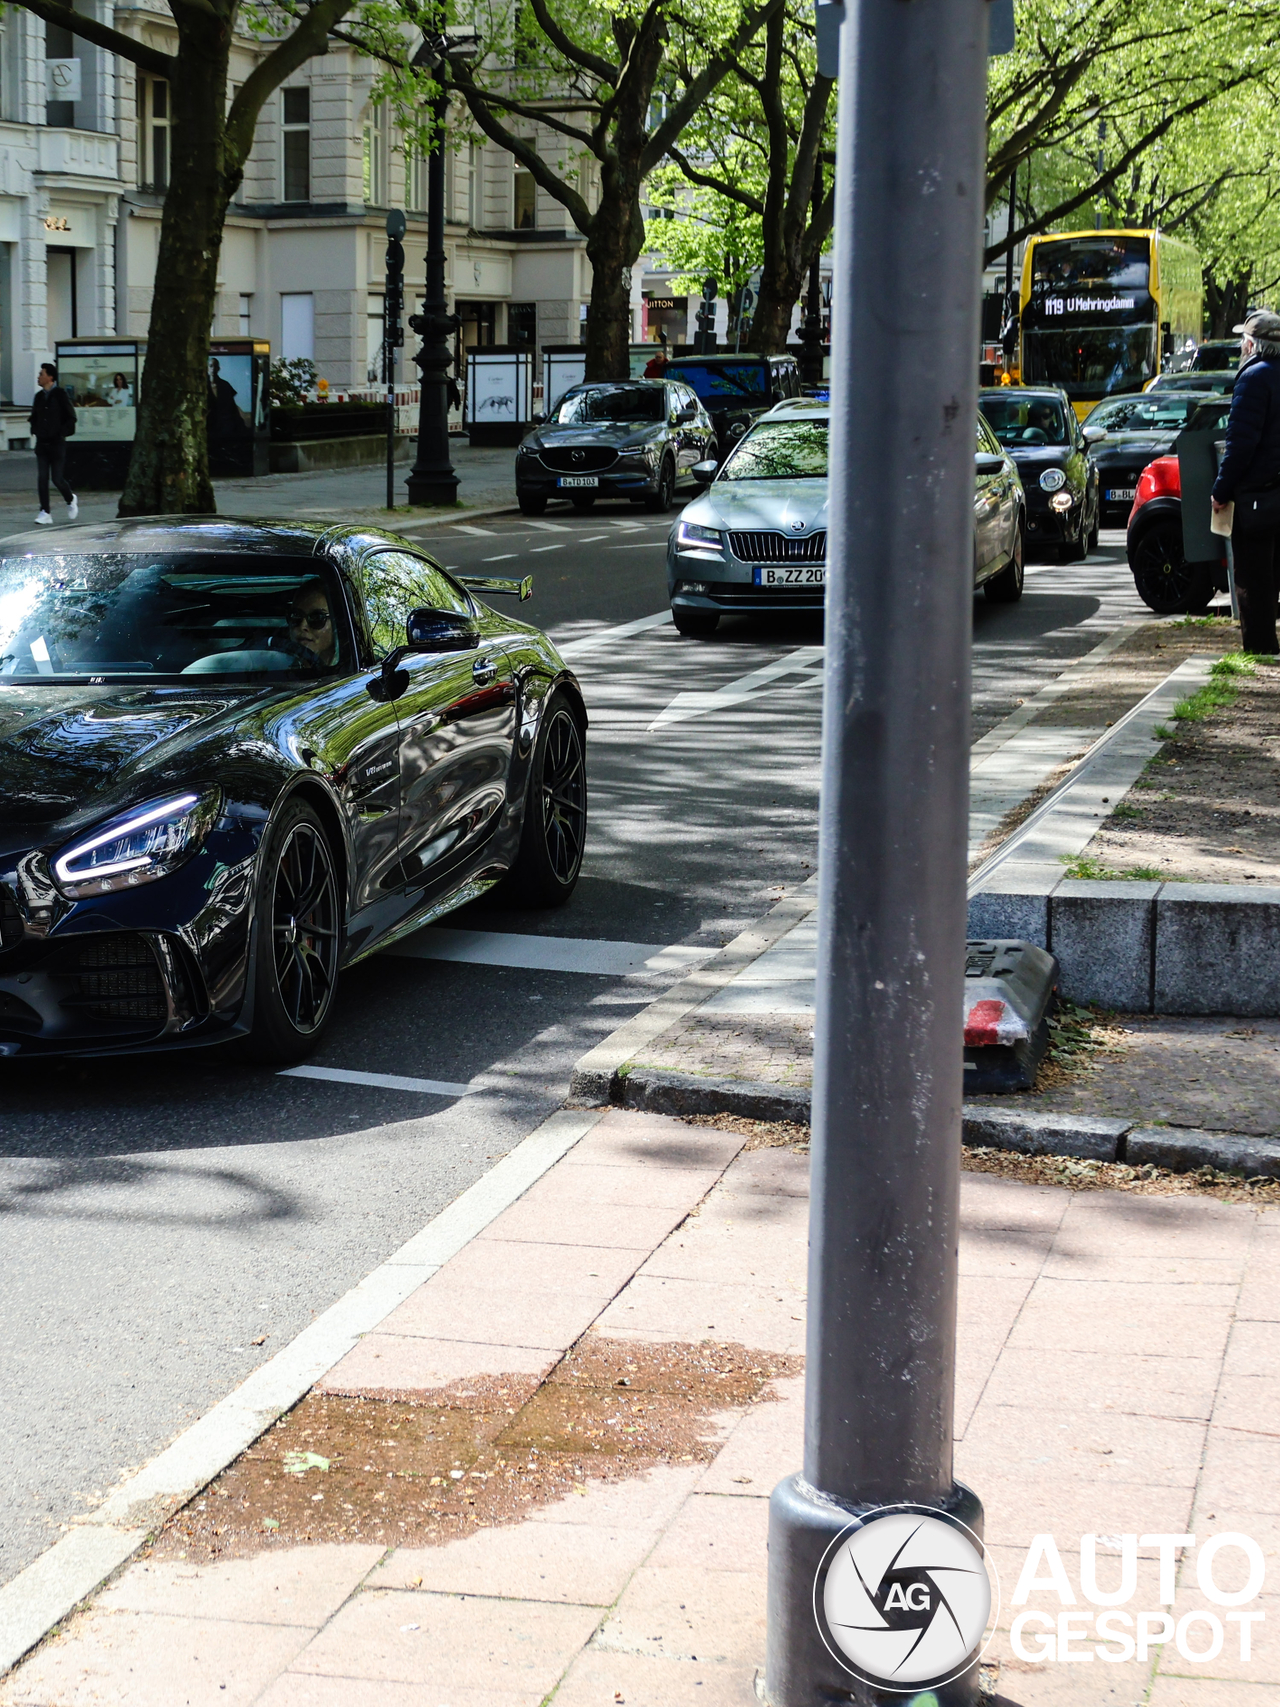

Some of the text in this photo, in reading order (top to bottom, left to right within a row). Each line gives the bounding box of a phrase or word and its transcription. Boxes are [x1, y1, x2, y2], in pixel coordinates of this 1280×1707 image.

[646, 300, 674, 308] UITTON
[1045, 295, 1134, 315] M19 U Mehringdamm
[767, 570, 776, 583] B
[785, 569, 803, 583] ZZ
